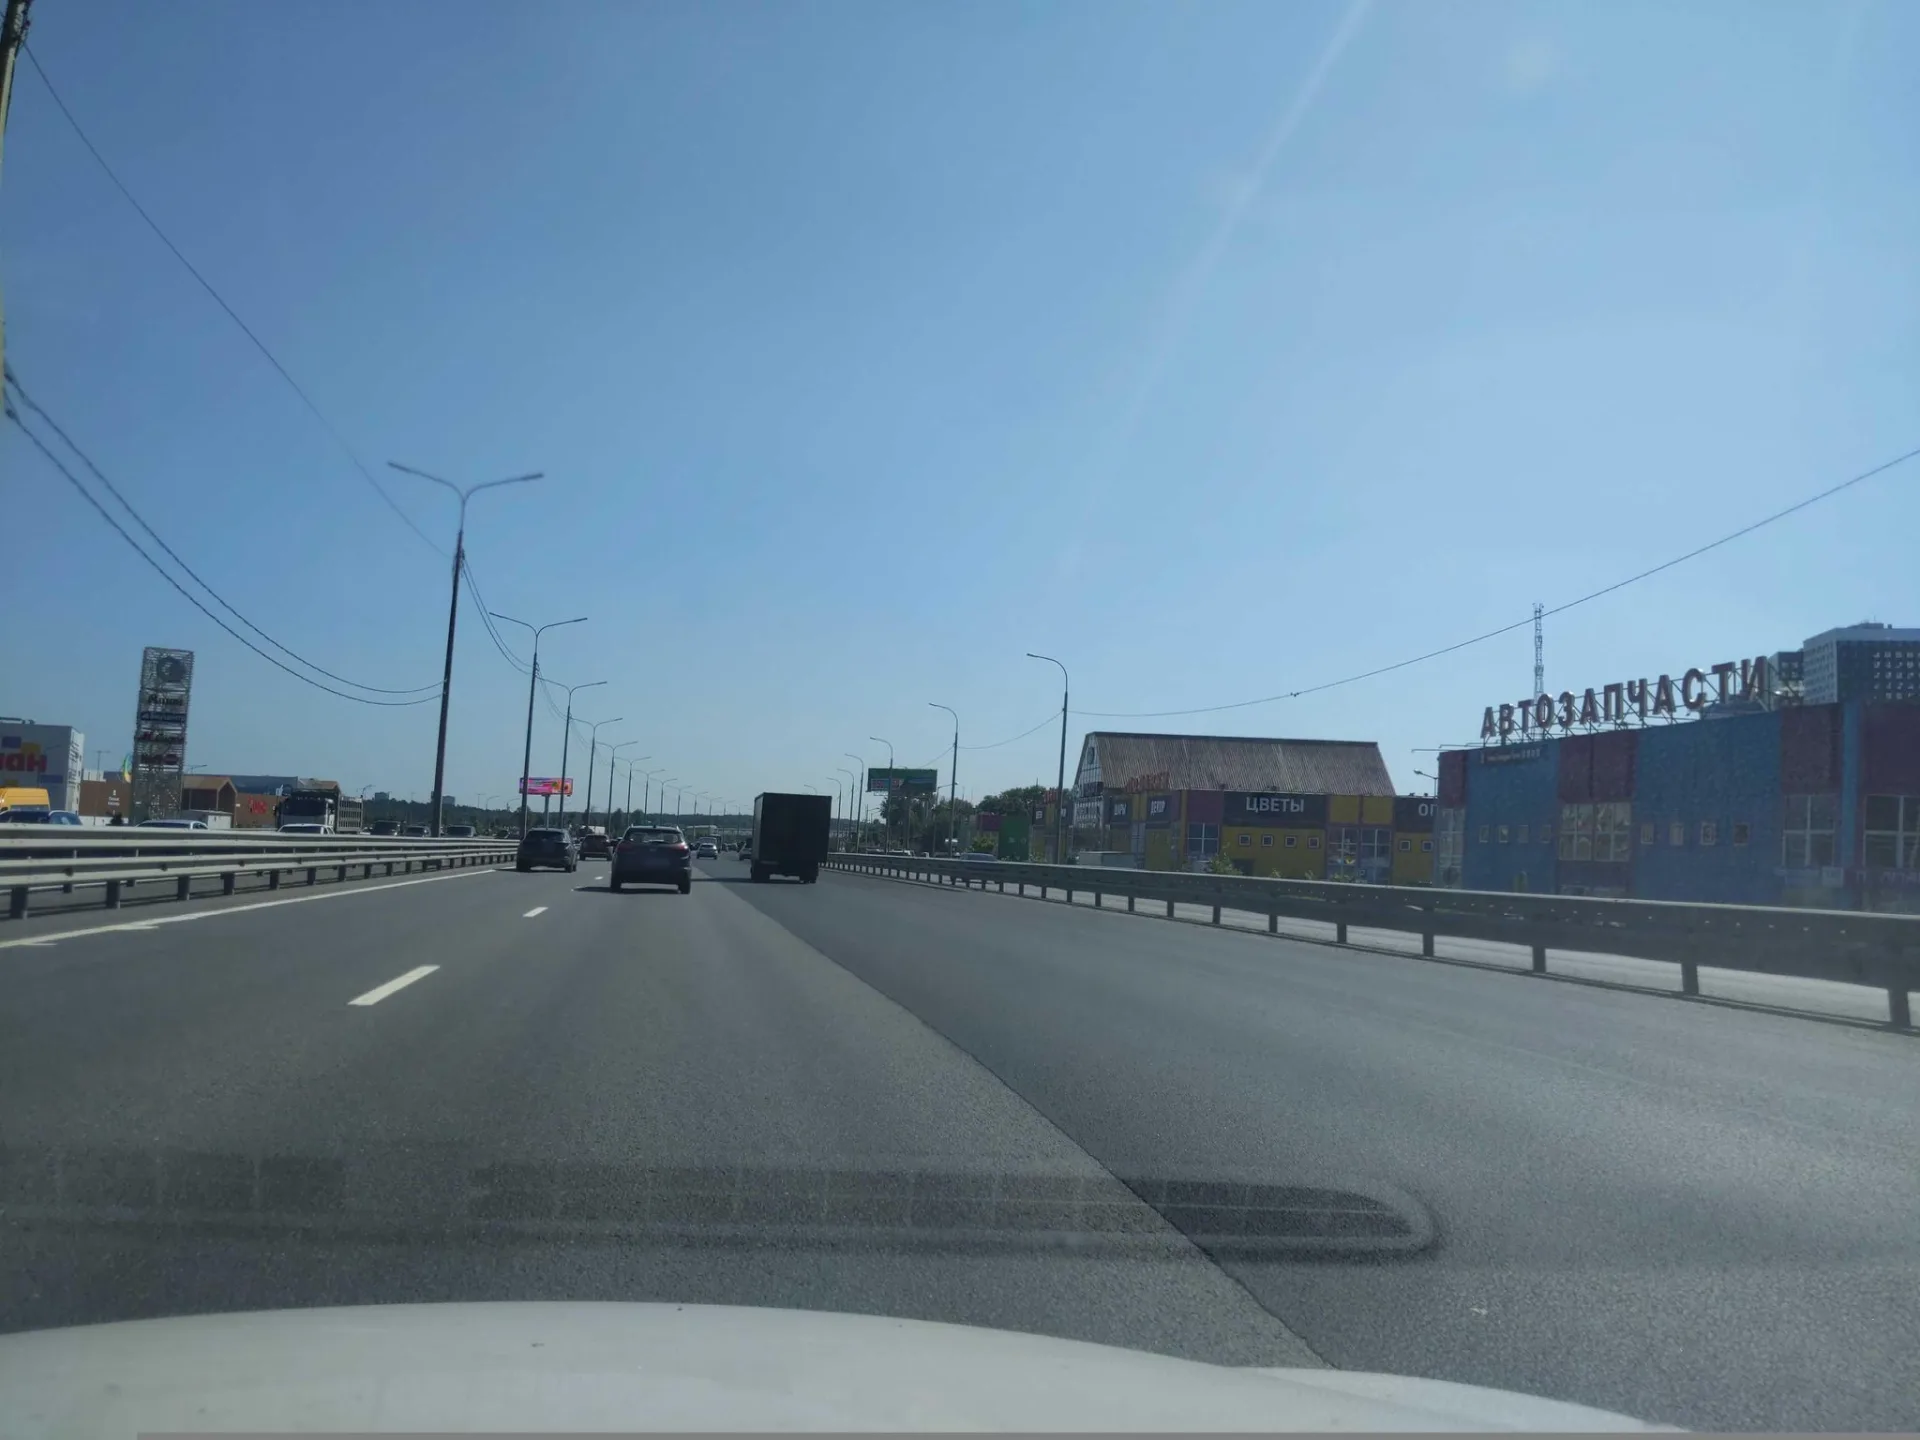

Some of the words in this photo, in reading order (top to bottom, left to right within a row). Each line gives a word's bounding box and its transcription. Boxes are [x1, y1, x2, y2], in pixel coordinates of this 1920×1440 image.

[1480, 655, 1769, 739] АВТОЗАПЧАСТИ
[0, 753, 46, 772] ан
[1245, 797, 1304, 813] ЦВЕТЫ
